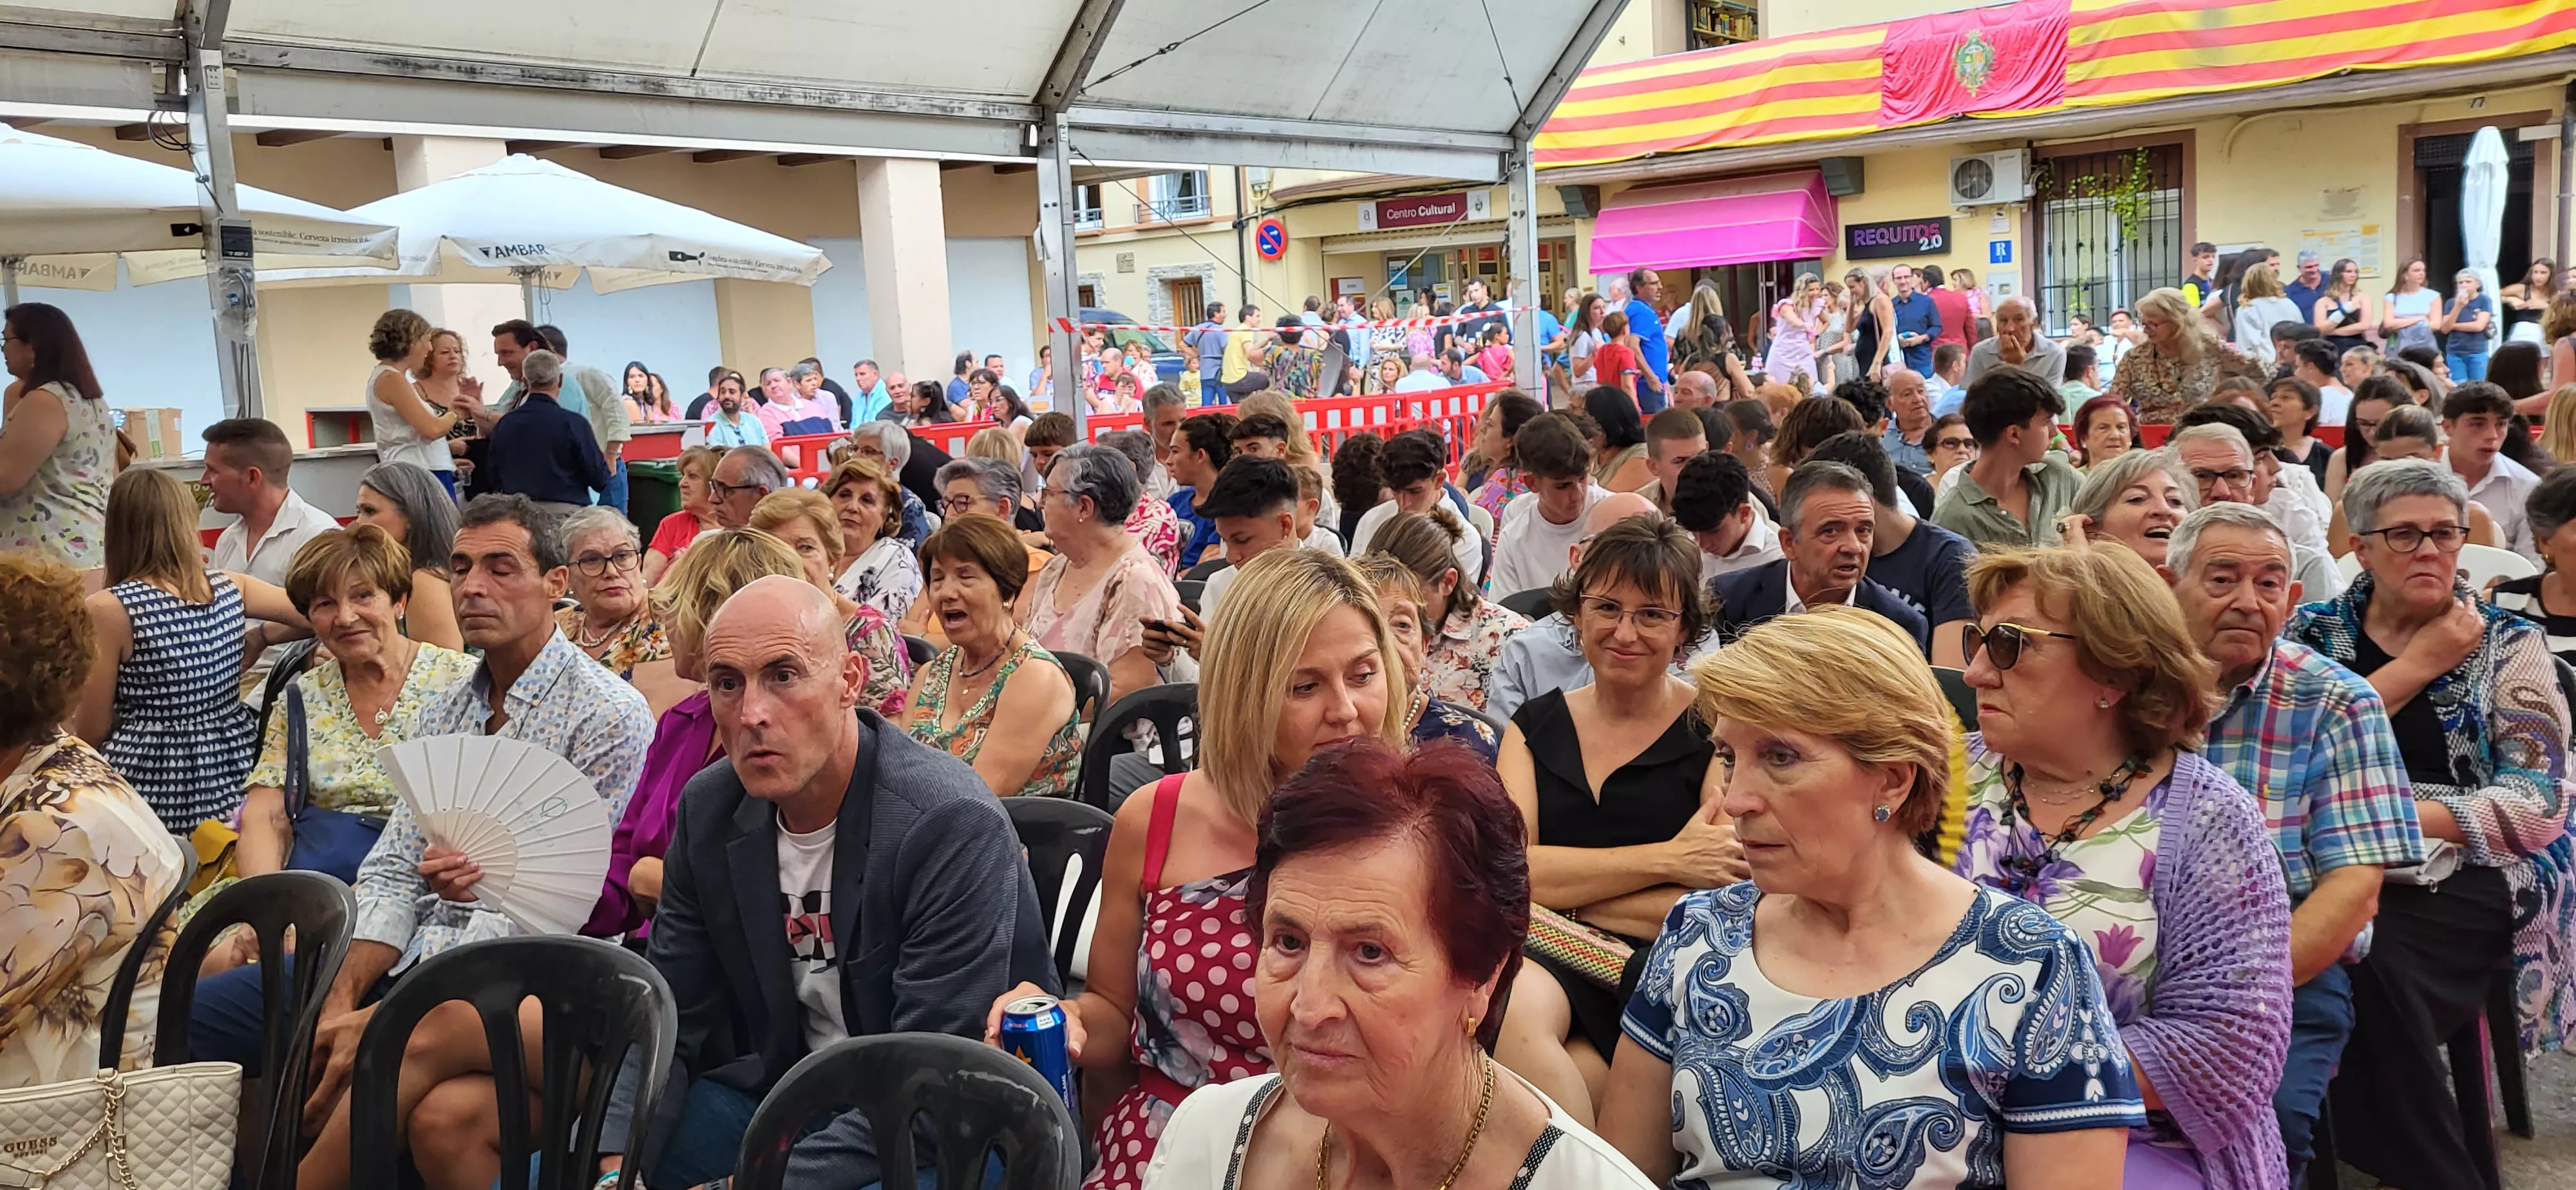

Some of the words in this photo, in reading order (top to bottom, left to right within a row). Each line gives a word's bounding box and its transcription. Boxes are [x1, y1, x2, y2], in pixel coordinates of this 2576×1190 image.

[1387, 207, 1417, 220] Centro
[1418, 202, 1456, 217] Cultural
[299, 232, 329, 243] Cerveza
[1854, 223, 1940, 247] REQUITOS
[1918, 234, 1943, 251] 2.0
[495, 244, 550, 258] AMBAR
[1995, 242, 2007, 256] R
[4, 1137, 57, 1153] GUESS
